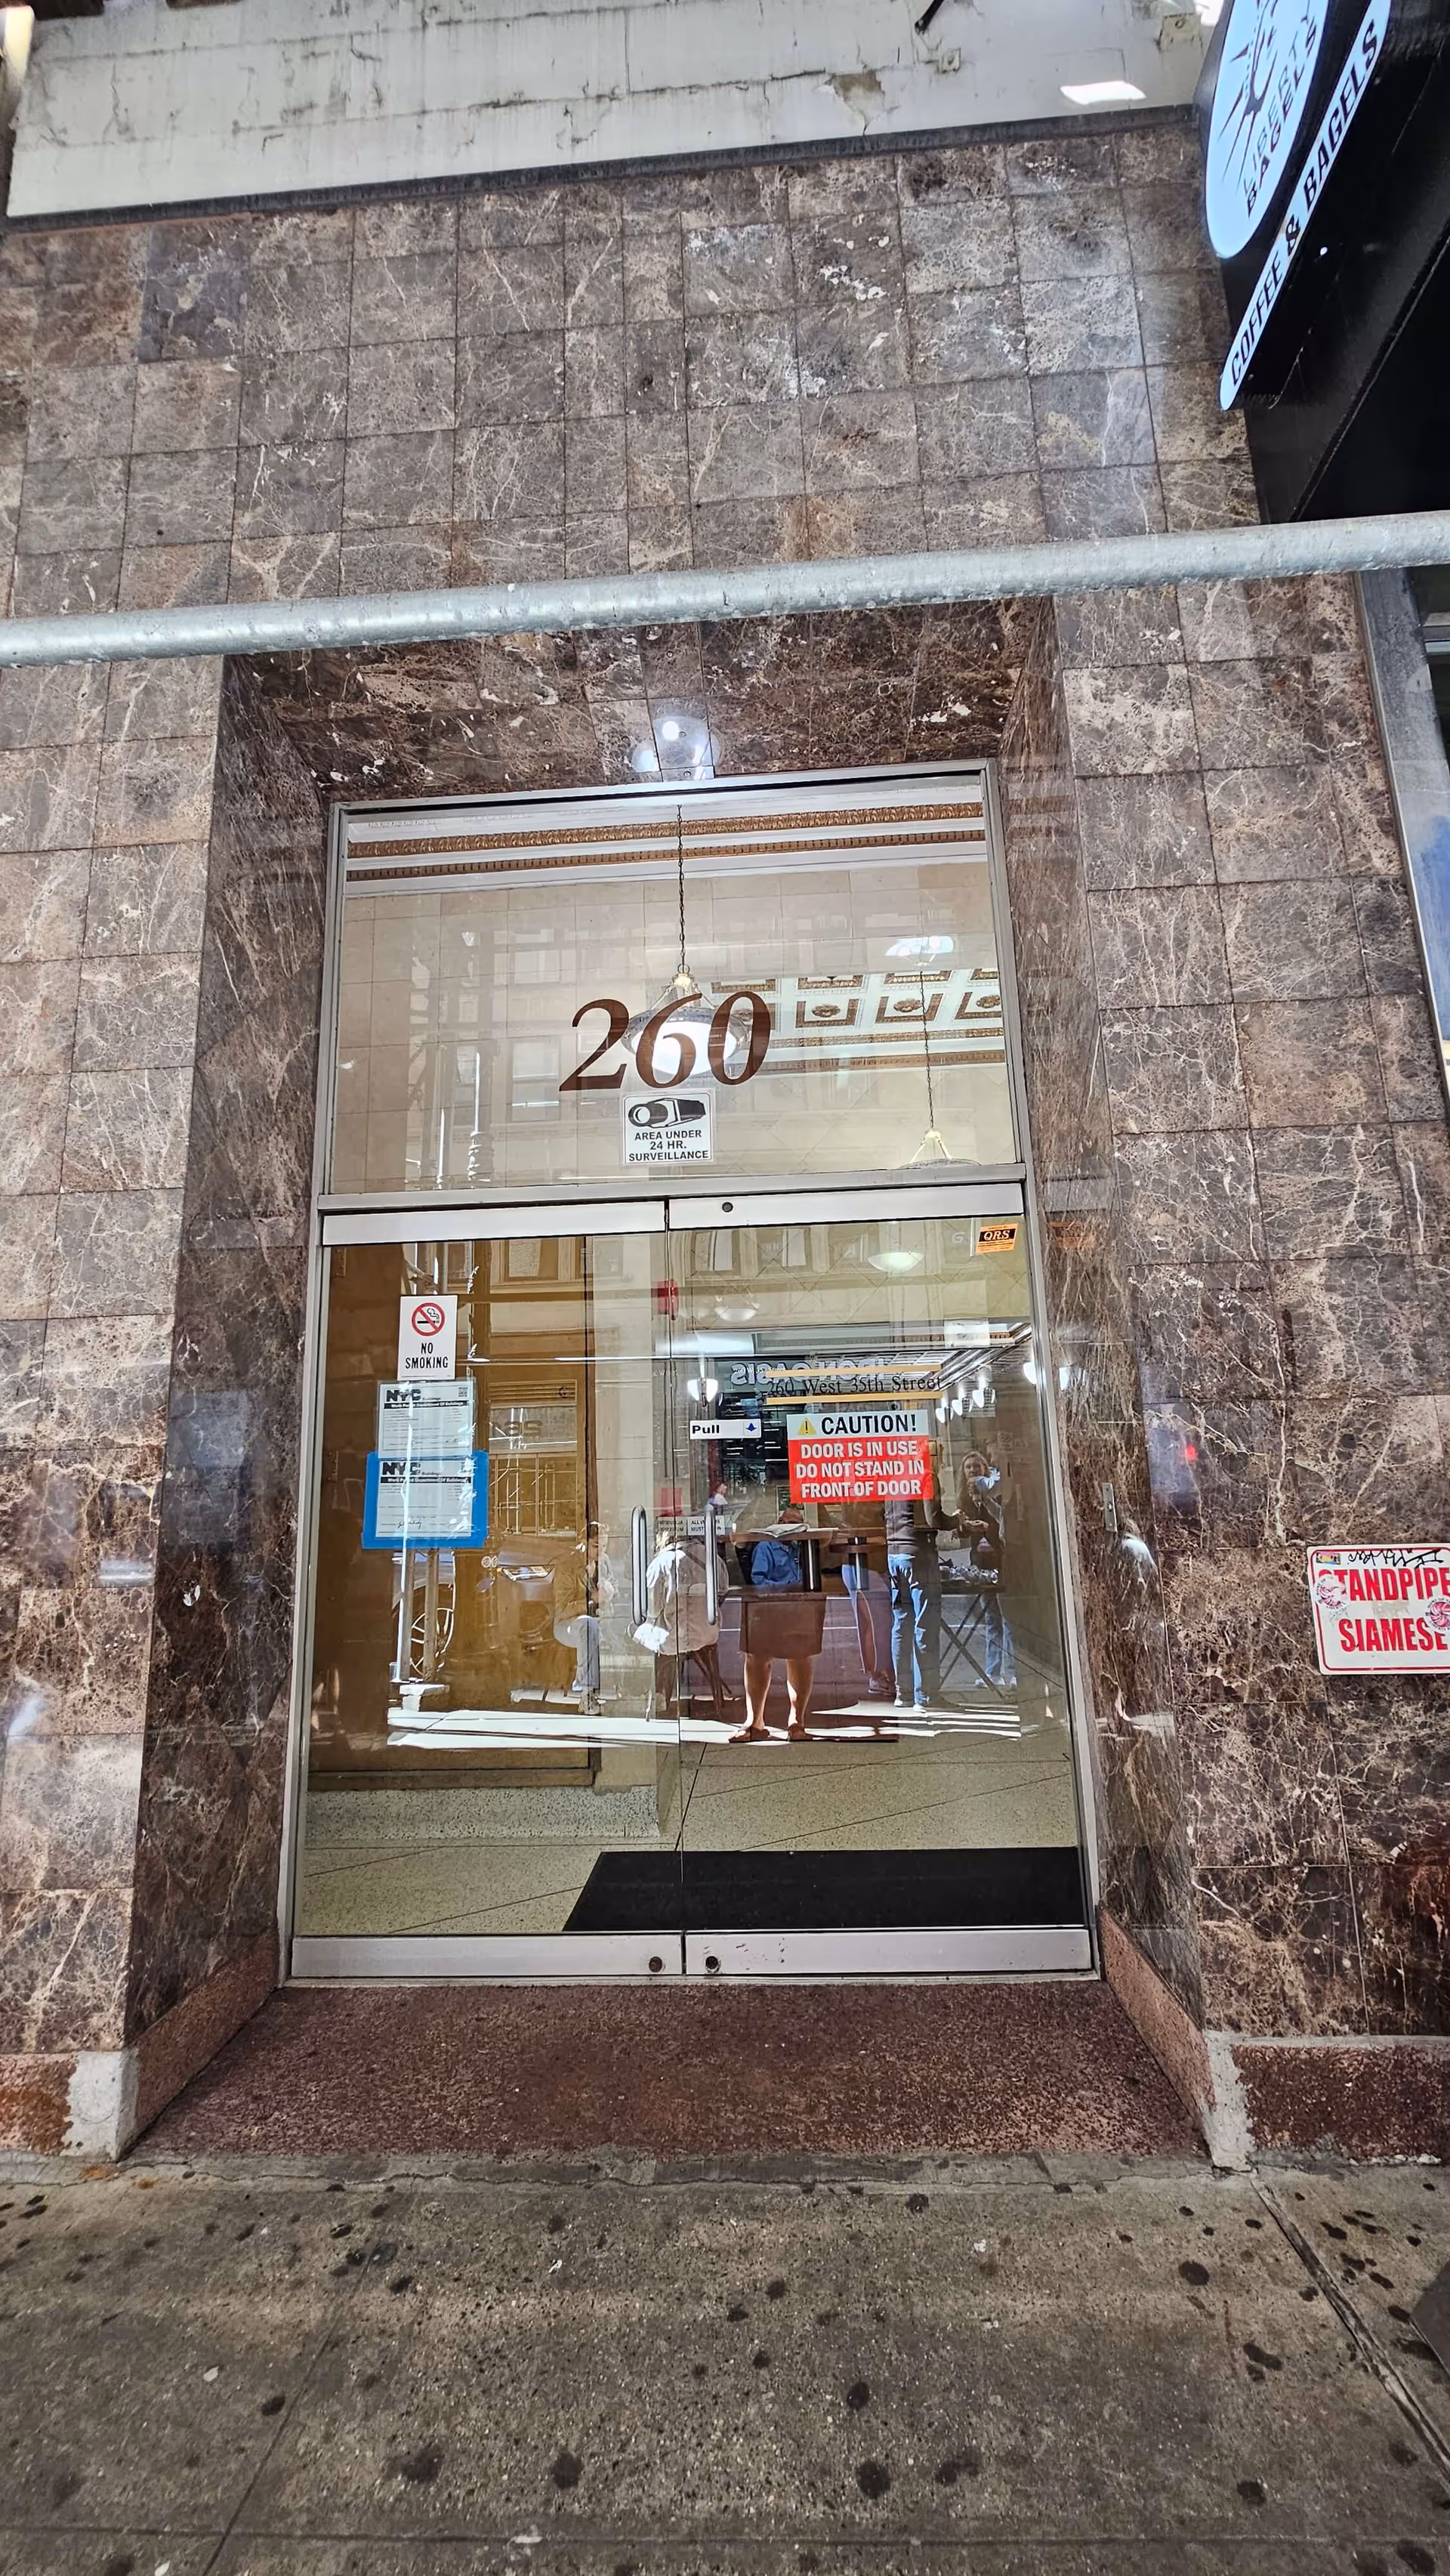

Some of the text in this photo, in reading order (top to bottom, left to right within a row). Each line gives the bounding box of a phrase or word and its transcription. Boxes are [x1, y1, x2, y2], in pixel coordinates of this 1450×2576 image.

[1247, 15, 1316, 218] BAGELS
[1231, 19, 1378, 387] COFFEE & BAGELS
[559, 990, 771, 1092] 260
[635, 1130, 702, 1141] AREA UNDER
[649, 1140, 686, 1150] 24 HR.
[629, 1151, 708, 1161] SURVEILLANCE
[983, 1230, 1010, 1240] QRS
[421, 1342, 433, 1354] NO
[405, 1356, 449, 1369] SMOKING
[768, 1375, 942, 1397] 260 West 35th Street
[386, 1389, 421, 1401] NYC
[692, 1424, 720, 1434] Pull
[821, 1414, 916, 1435] CAUTION!
[801, 1441, 918, 1459] DOOR IS IN USE
[382, 1462, 421, 1475] NYC
[796, 1459, 924, 1478] DO NOT STAND IN
[801, 1480, 921, 1498] FRONT OF DOOR
[1319, 1568, 1450, 1601] TANDPIPE
